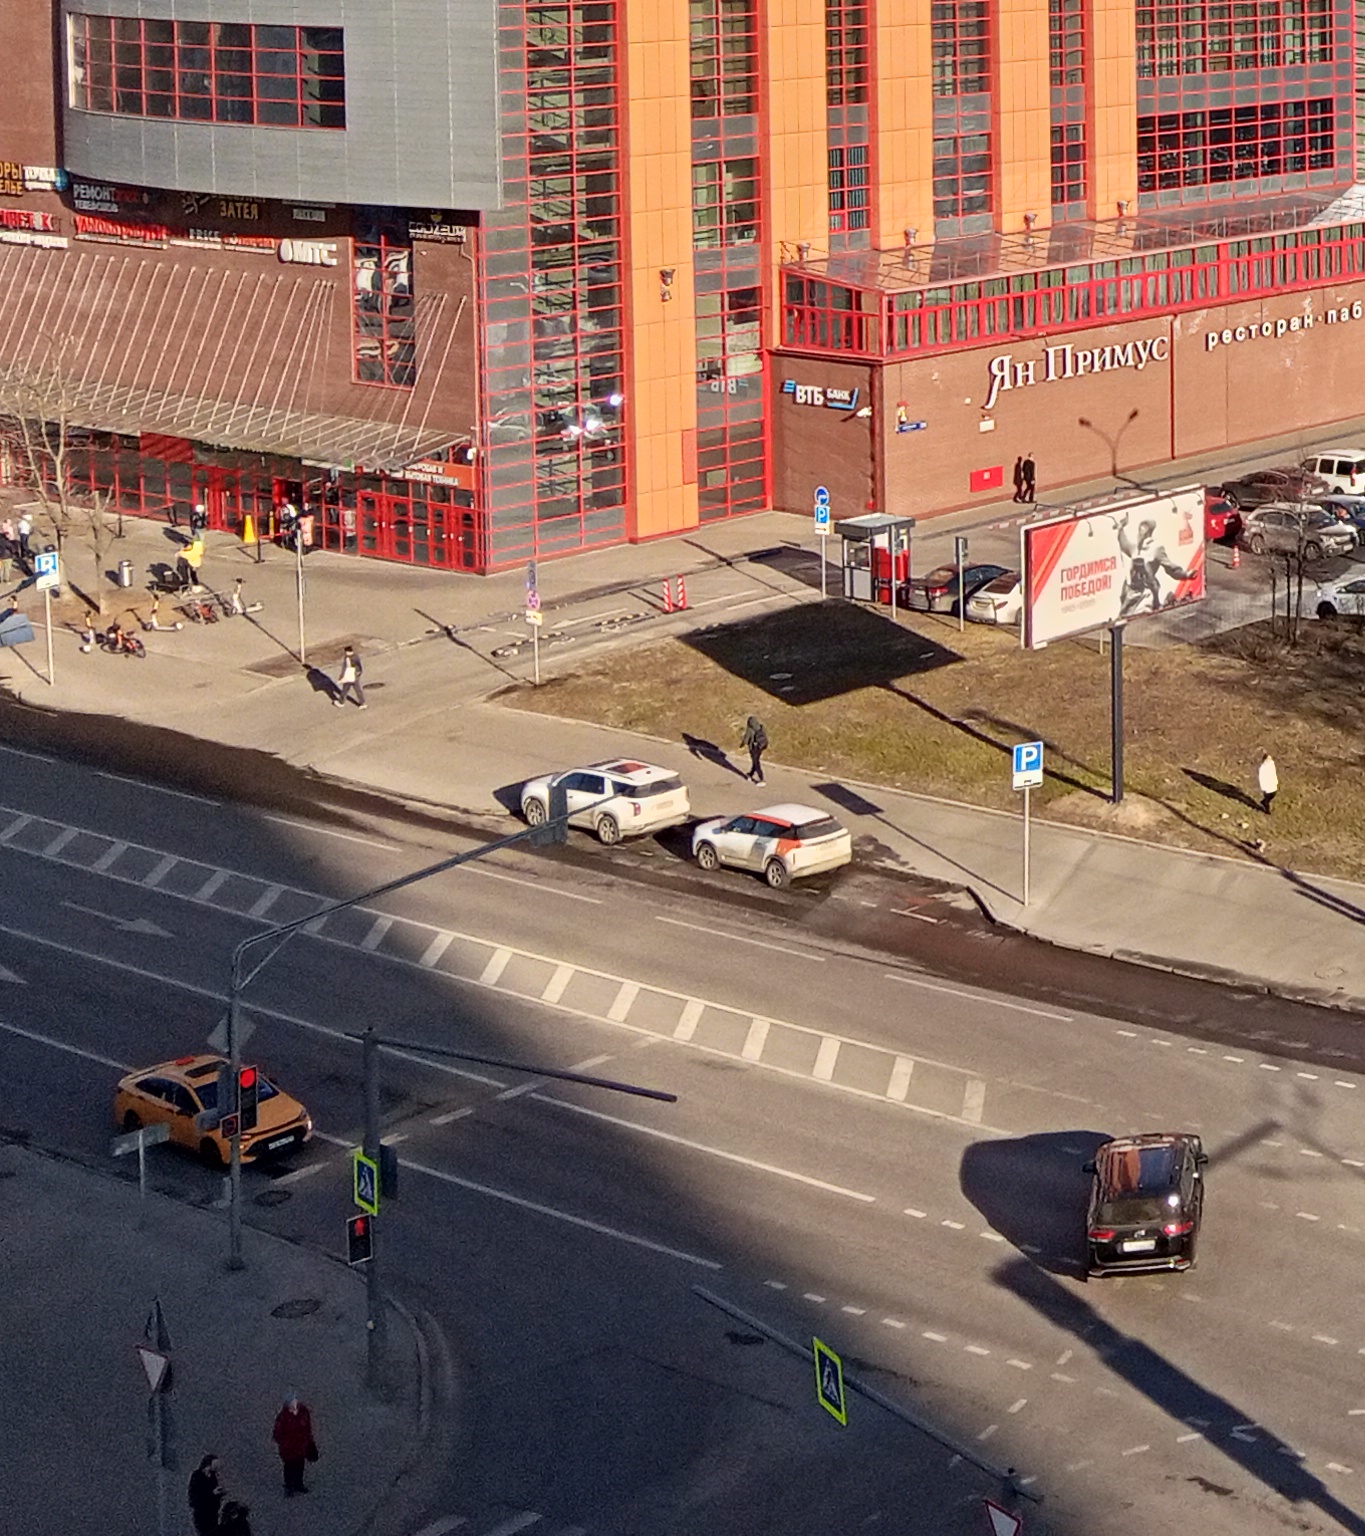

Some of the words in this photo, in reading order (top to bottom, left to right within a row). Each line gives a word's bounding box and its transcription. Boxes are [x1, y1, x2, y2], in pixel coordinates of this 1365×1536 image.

[73, 183, 116, 201] РЕМОНТ
[219, 201, 259, 220] ЗАТЕЯ
[293, 240, 337, 266] МТС
[1207, 313, 1315, 351] ресторан
[1326, 300, 1363, 324] паб
[984, 354, 1037, 410] Ян
[1045, 336, 1168, 382] Примус
[796, 385, 824, 406] ВТБ
[827, 388, 851, 401] БАНК
[1061, 556, 1117, 584] ГОРДИМСЯ
[1061, 575, 1112, 601] ПОБЕДОЙ!
[1021, 746, 1038, 771] P
